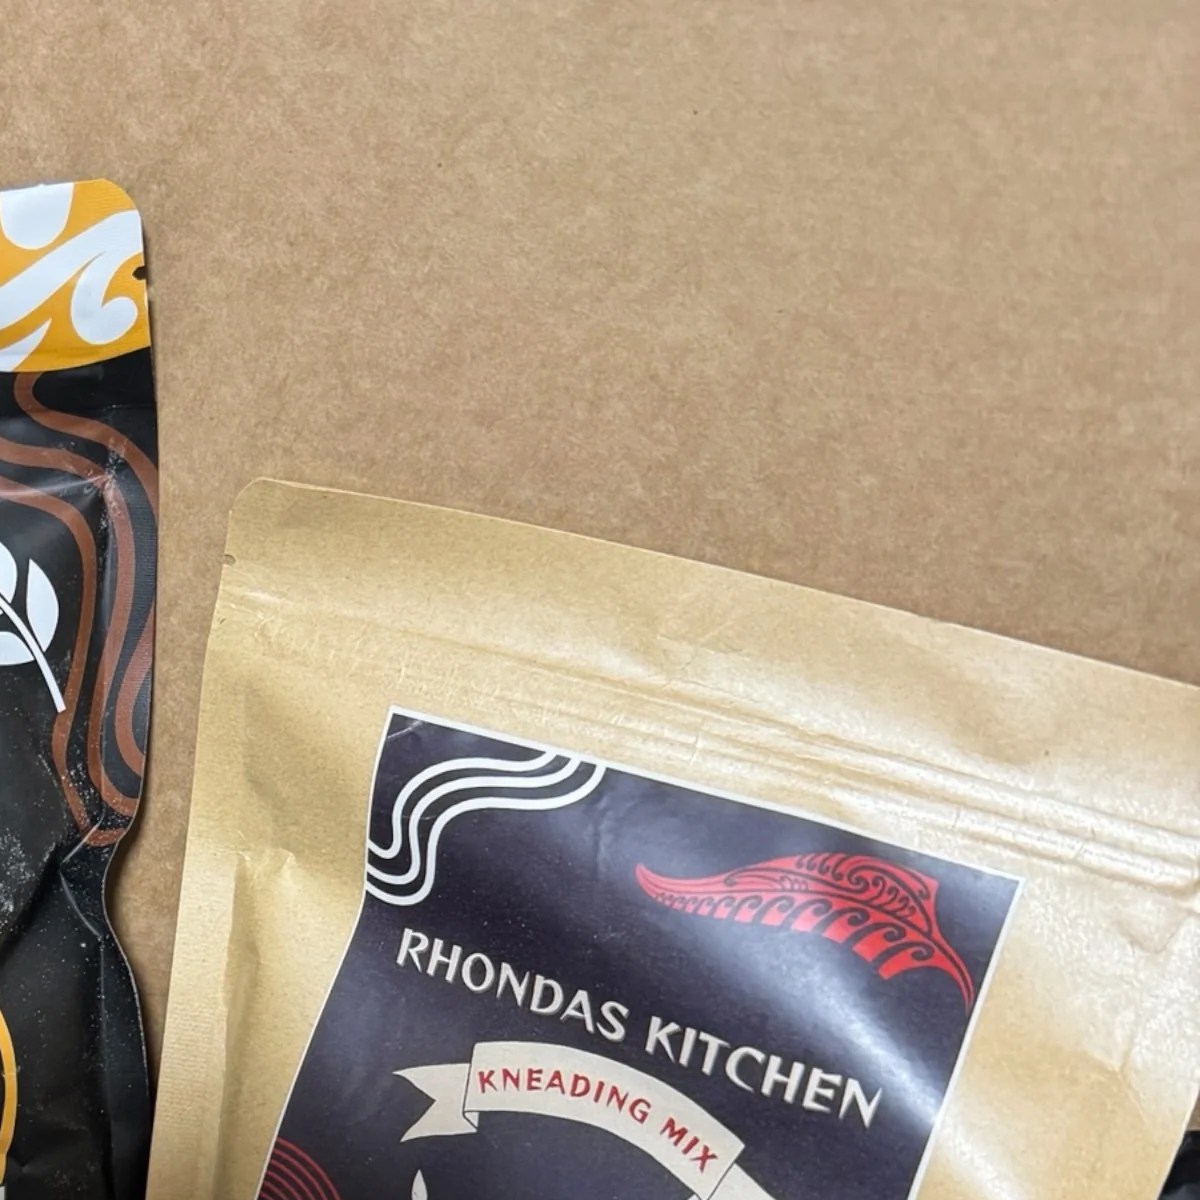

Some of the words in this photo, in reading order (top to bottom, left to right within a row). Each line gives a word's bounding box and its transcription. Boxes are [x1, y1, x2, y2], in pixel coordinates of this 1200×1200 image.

[396, 928, 630, 1044] RHONDAS
[644, 1016, 884, 1130] KITCHEN
[477, 1067, 651, 1125] KNEADING
[659, 1117, 719, 1173] MIX
